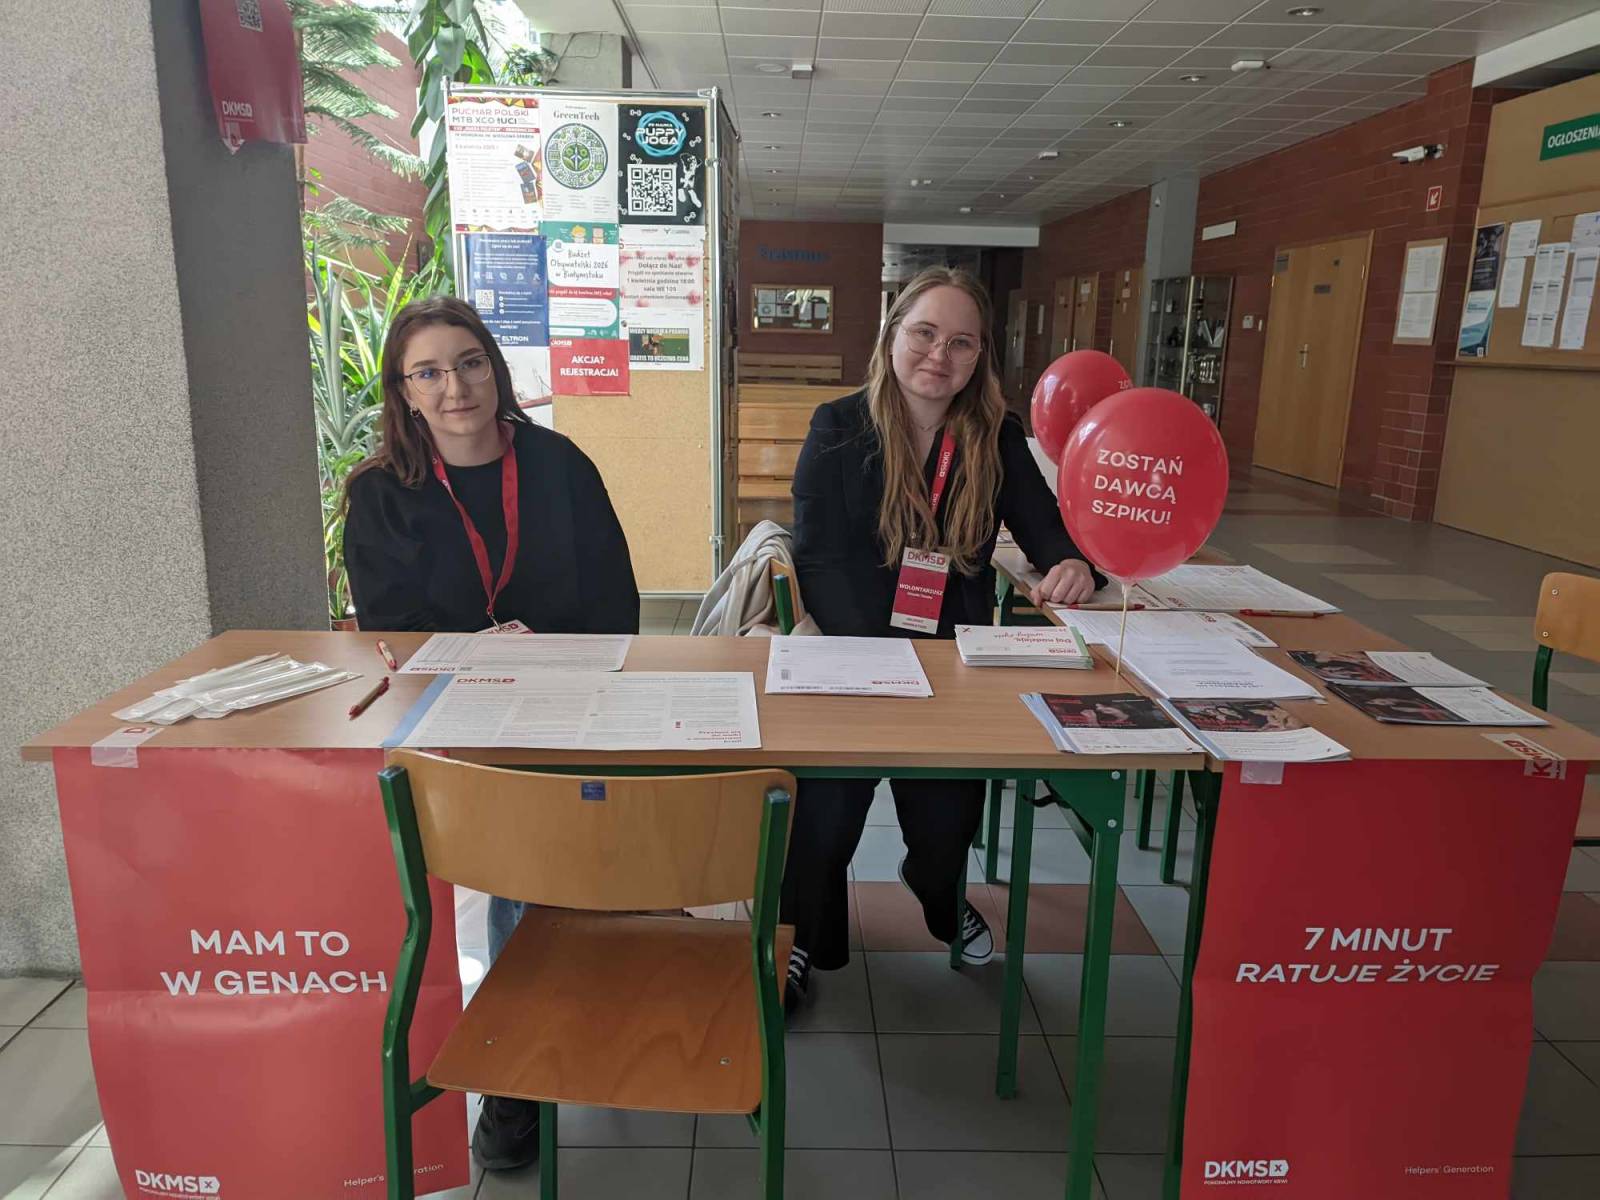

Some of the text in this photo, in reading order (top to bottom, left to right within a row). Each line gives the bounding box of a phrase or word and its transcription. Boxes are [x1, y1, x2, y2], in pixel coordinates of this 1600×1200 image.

[222, 100, 247, 117] DKMS
[452, 107, 528, 116] PUCHAR POLSKI
[553, 110, 600, 120] GreenTech
[637, 127, 685, 137] PUPPY
[641, 136, 679, 144] JOGA
[568, 249, 590, 258] Budżet
[551, 259, 591, 270] Obywatelski
[571, 355, 605, 364] AKCJA?
[560, 367, 619, 377] REJESTRACJA!
[1096, 449, 1183, 476] ZOSTAŃ
[1094, 474, 1177, 504] DAWCĄ
[1091, 499, 1172, 525] SZPIKU!
[907, 551, 936, 565] DKMS
[190, 929, 350, 957] MAM TO
[1305, 927, 1453, 951] 7 MINUT
[1235, 958, 1500, 983] RATUJE ŻYCIE
[160, 970, 387, 996] W GENACH
[413, 1163, 444, 1176] ration
[1204, 1160, 1269, 1178] DKMS
[1443, 1164, 1494, 1175] Generation
[135, 1169, 198, 1193] DKMS
